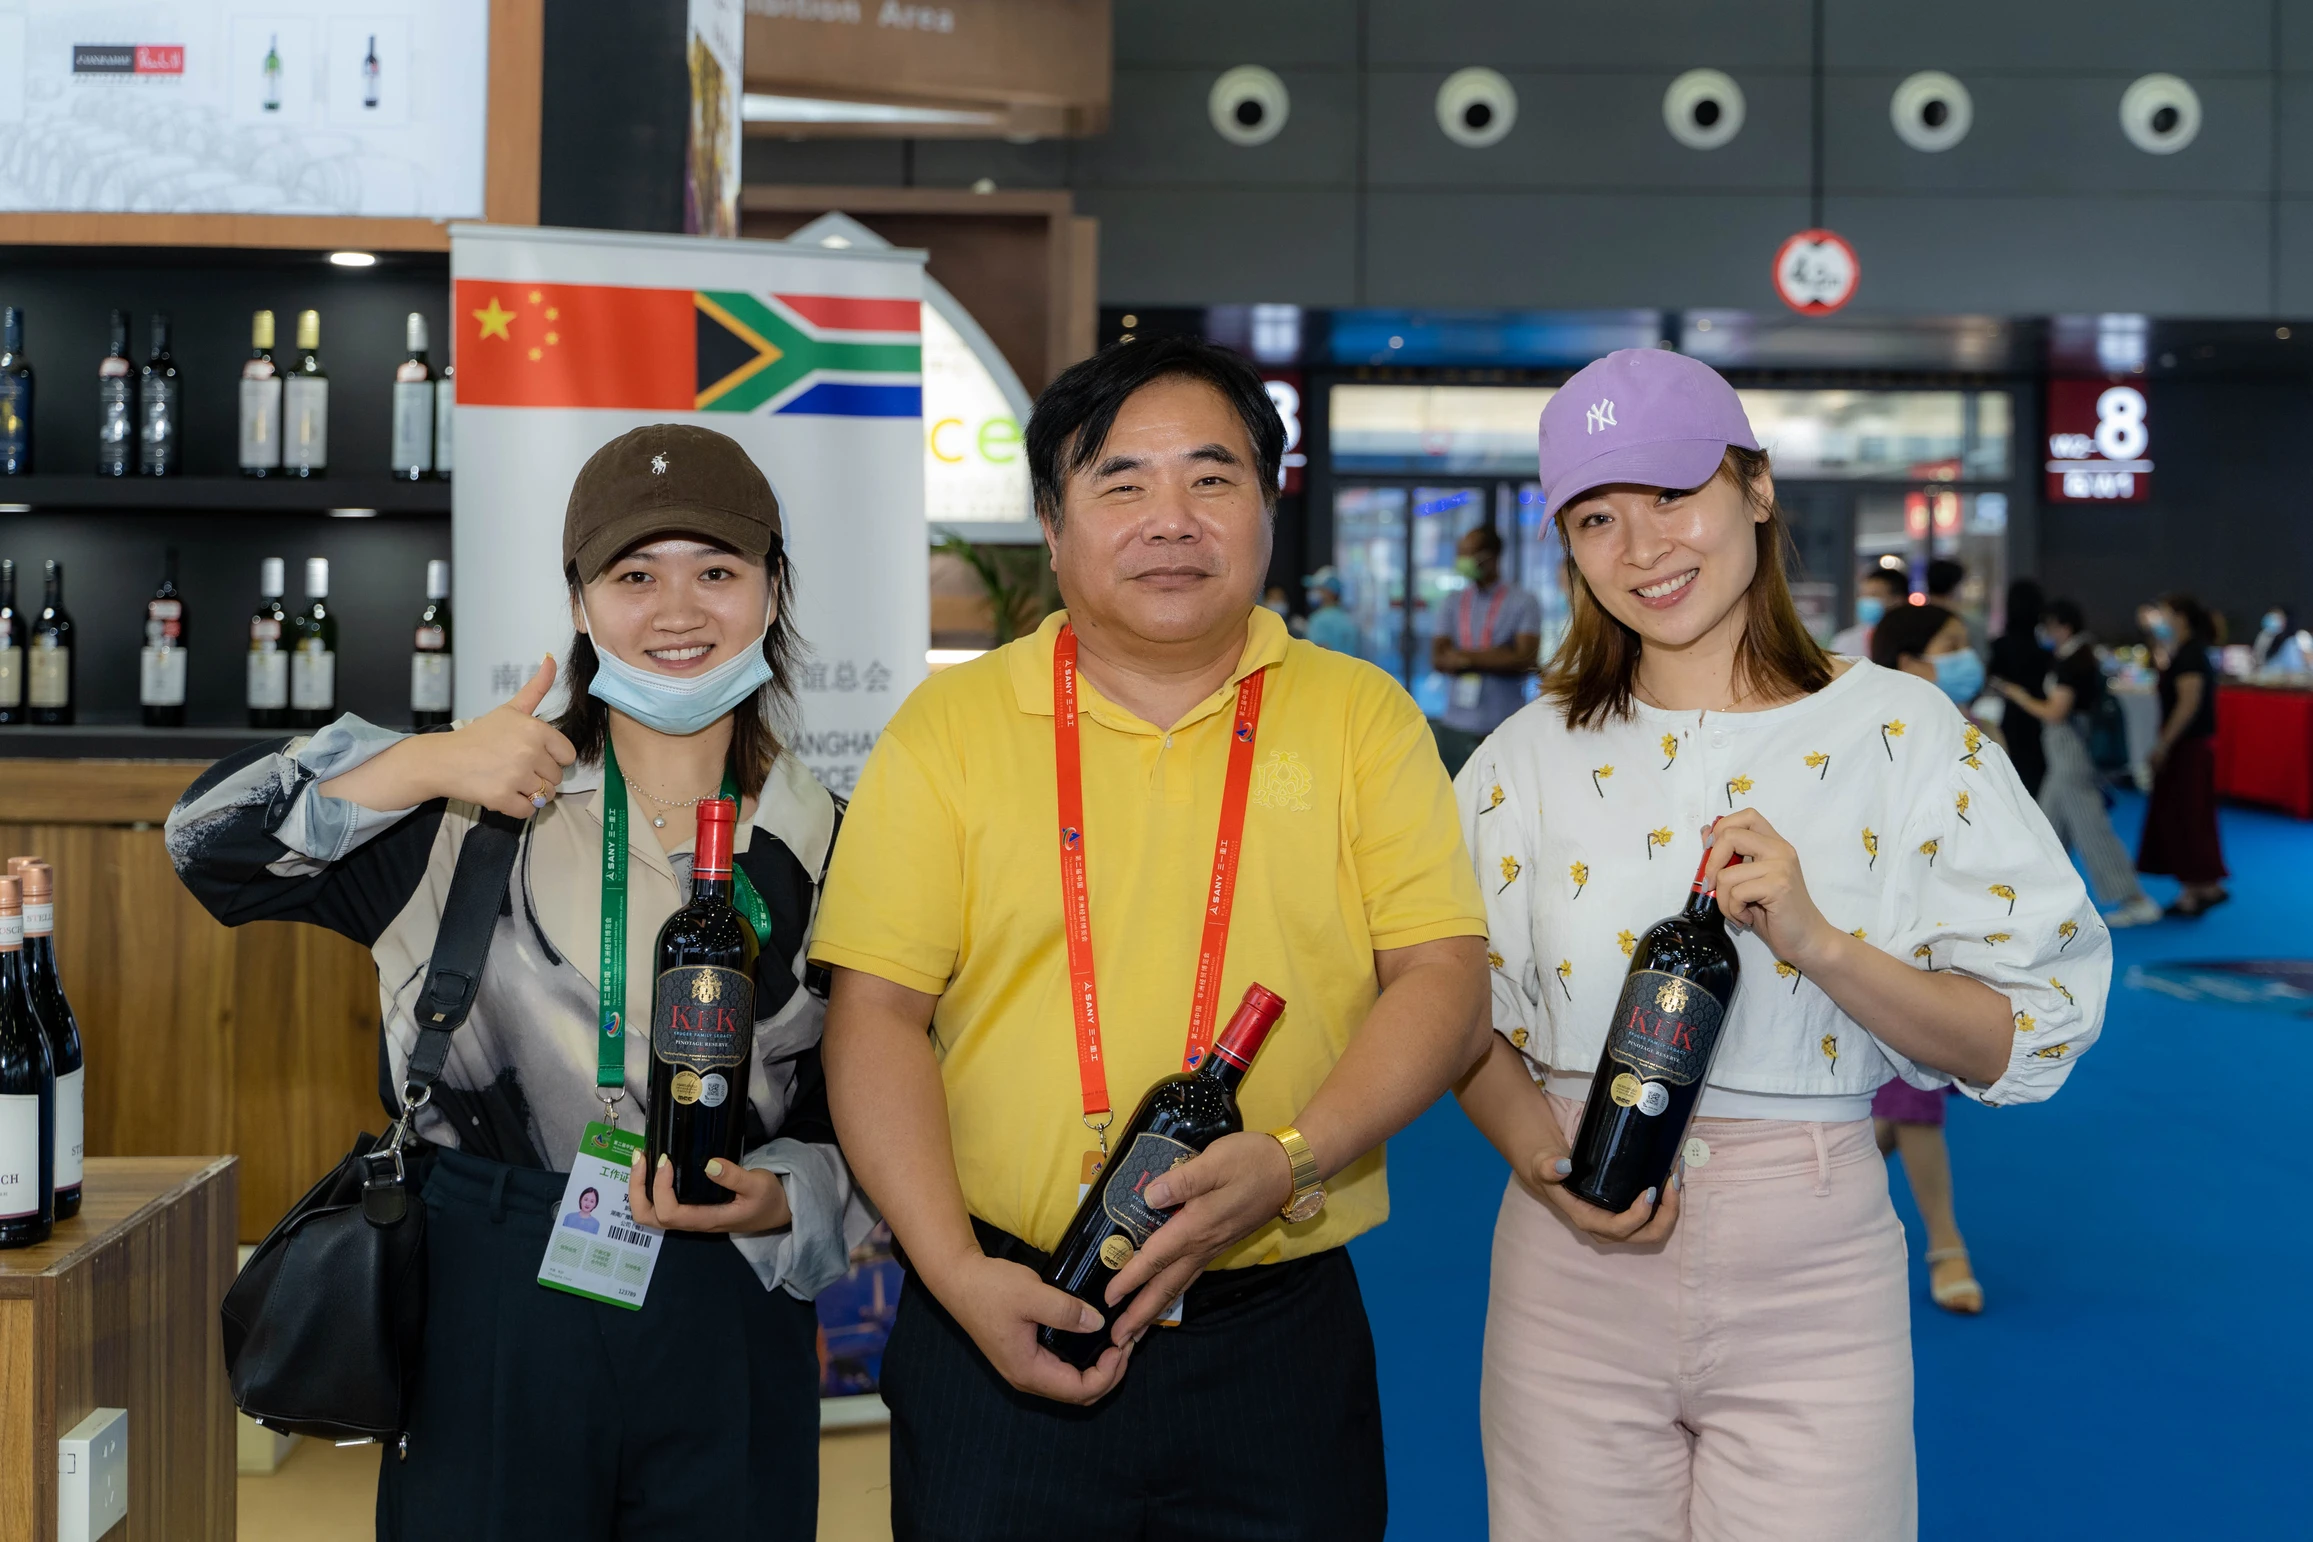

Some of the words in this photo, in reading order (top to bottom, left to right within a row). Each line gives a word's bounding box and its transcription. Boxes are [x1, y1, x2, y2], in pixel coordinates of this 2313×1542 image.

[877, 1, 955, 33] Area
[1586, 398, 1618, 435] NY
[1064, 668, 1072, 695] SANY
[1066, 698, 1074, 728] 三一重工
[608, 808, 617, 838] 三一重工
[607, 841, 616, 870] SANY
[1217, 839, 1228, 871] 三一重工
[1212, 874, 1223, 904] SANY
[1085, 993, 1095, 1024] SANY
[1089, 1028, 1099, 1062] 三一重工
[1628, 1040, 1654, 1054] PINOTAGE
[1655, 1050, 1680, 1063] RESERVE
[599, 1165, 631, 1184] 工作证
[1130, 1203, 1155, 1222] PINOTAGE
